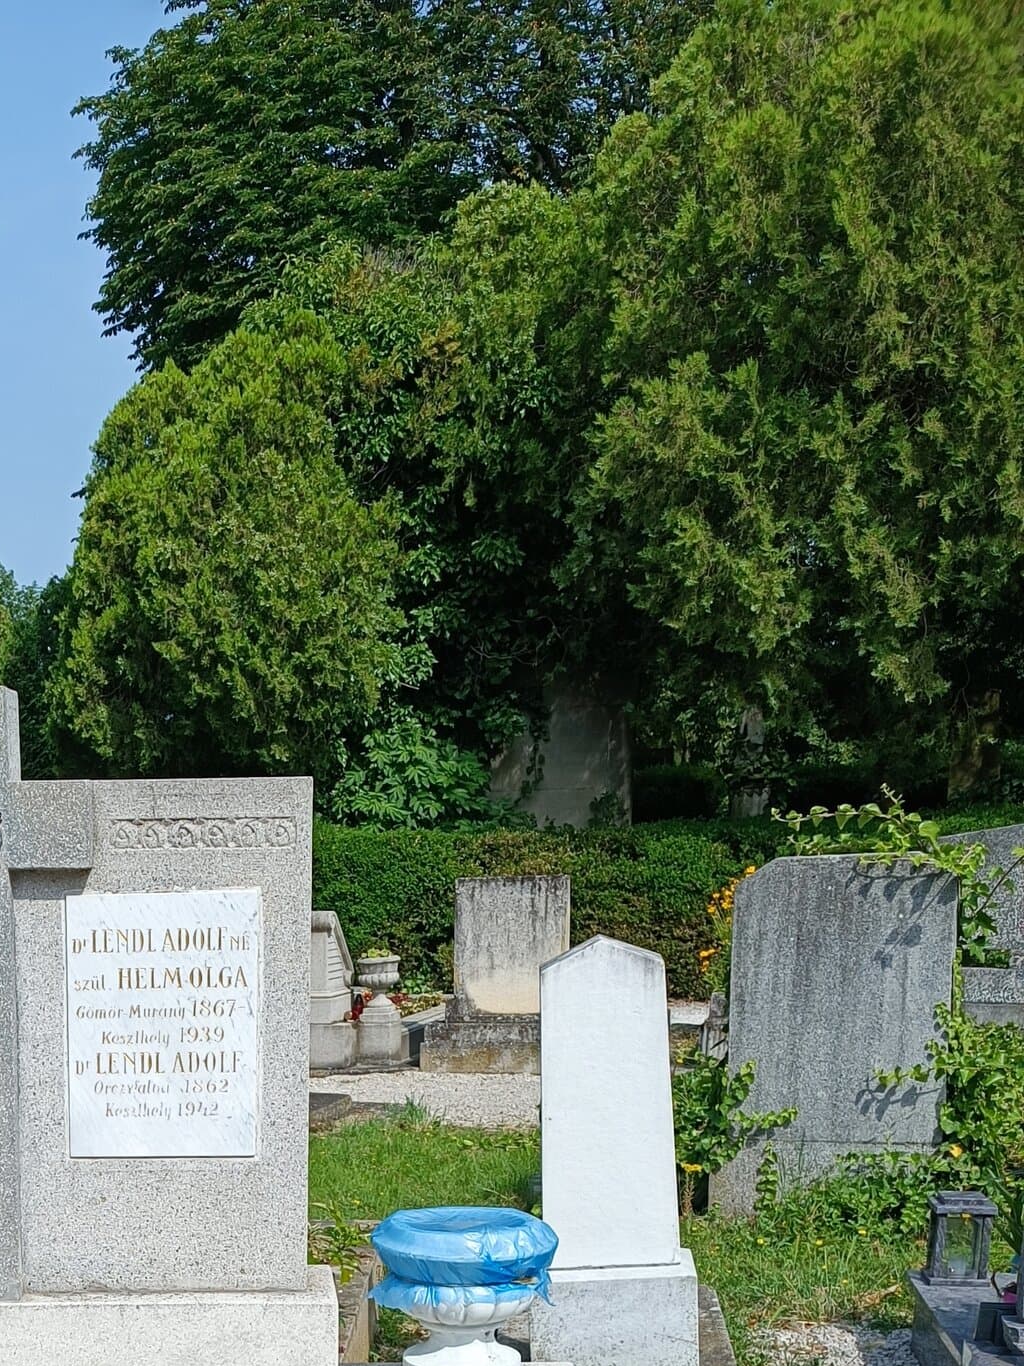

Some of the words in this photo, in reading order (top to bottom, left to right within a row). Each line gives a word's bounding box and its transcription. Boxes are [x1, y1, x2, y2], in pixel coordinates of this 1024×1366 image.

[90, 928, 157, 954] LENDL
[118, 967, 182, 991] HELM
[189, 965, 248, 990] OLGA
[101, 1030, 170, 1048] Keszthely
[180, 1026, 225, 1043] 1939
[96, 1052, 166, 1074] LENDL
[172, 1050, 244, 1074] ADOLF
[183, 1079, 230, 1094] 1862
[177, 1101, 219, 1118] 1942
